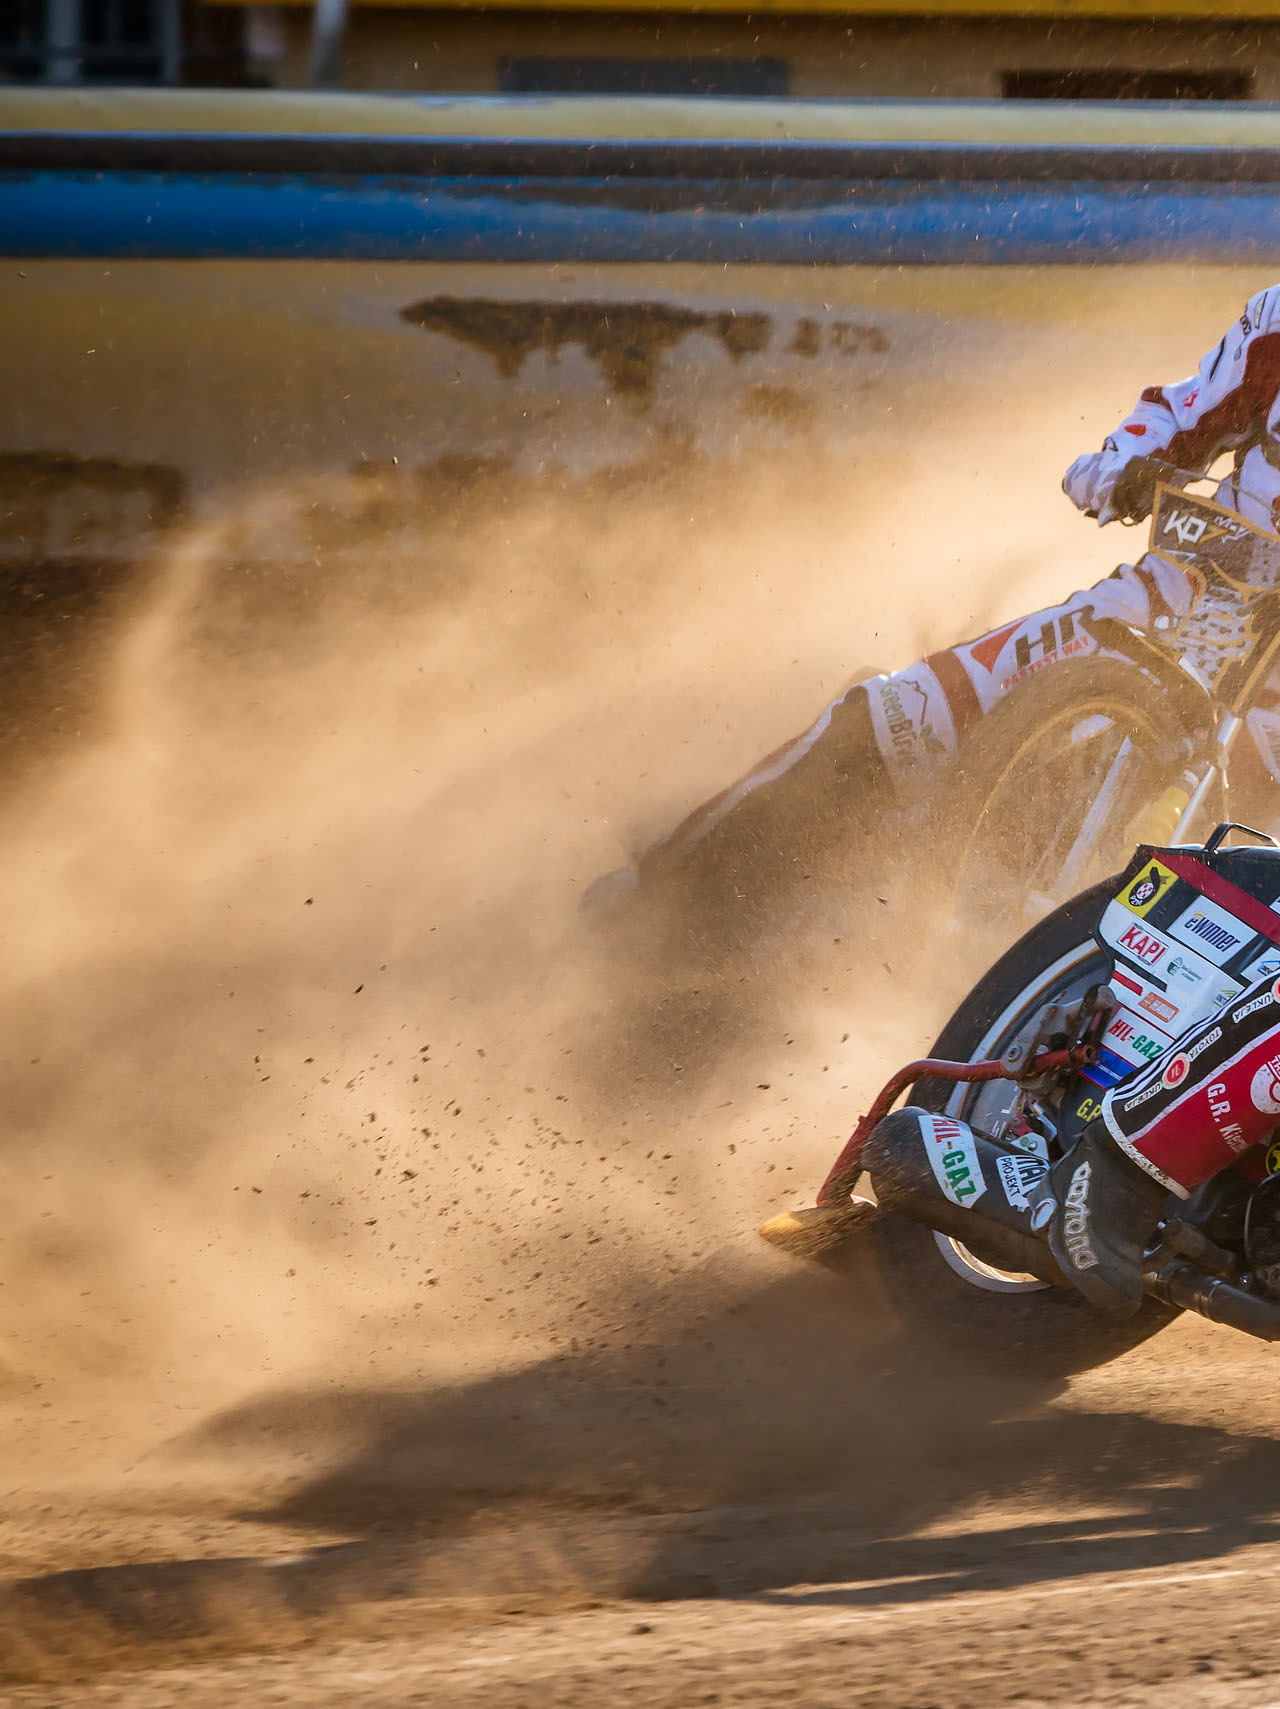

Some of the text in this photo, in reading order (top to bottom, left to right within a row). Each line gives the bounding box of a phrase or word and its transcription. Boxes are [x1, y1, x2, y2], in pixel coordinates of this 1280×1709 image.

[1120, 926, 1166, 964] KAPI
[1233, 991, 1272, 1023] UKLEJA
[1108, 1018, 1164, 1060] HIL-GAZ
[1190, 1028, 1221, 1060] TOYOTA
[1125, 1082, 1162, 1111] UKLEJA
[1207, 1083, 1231, 1123] G.R.
[932, 1117, 977, 1204] HIL-GAZ
[1001, 1157, 1021, 1197] PROJEKT
